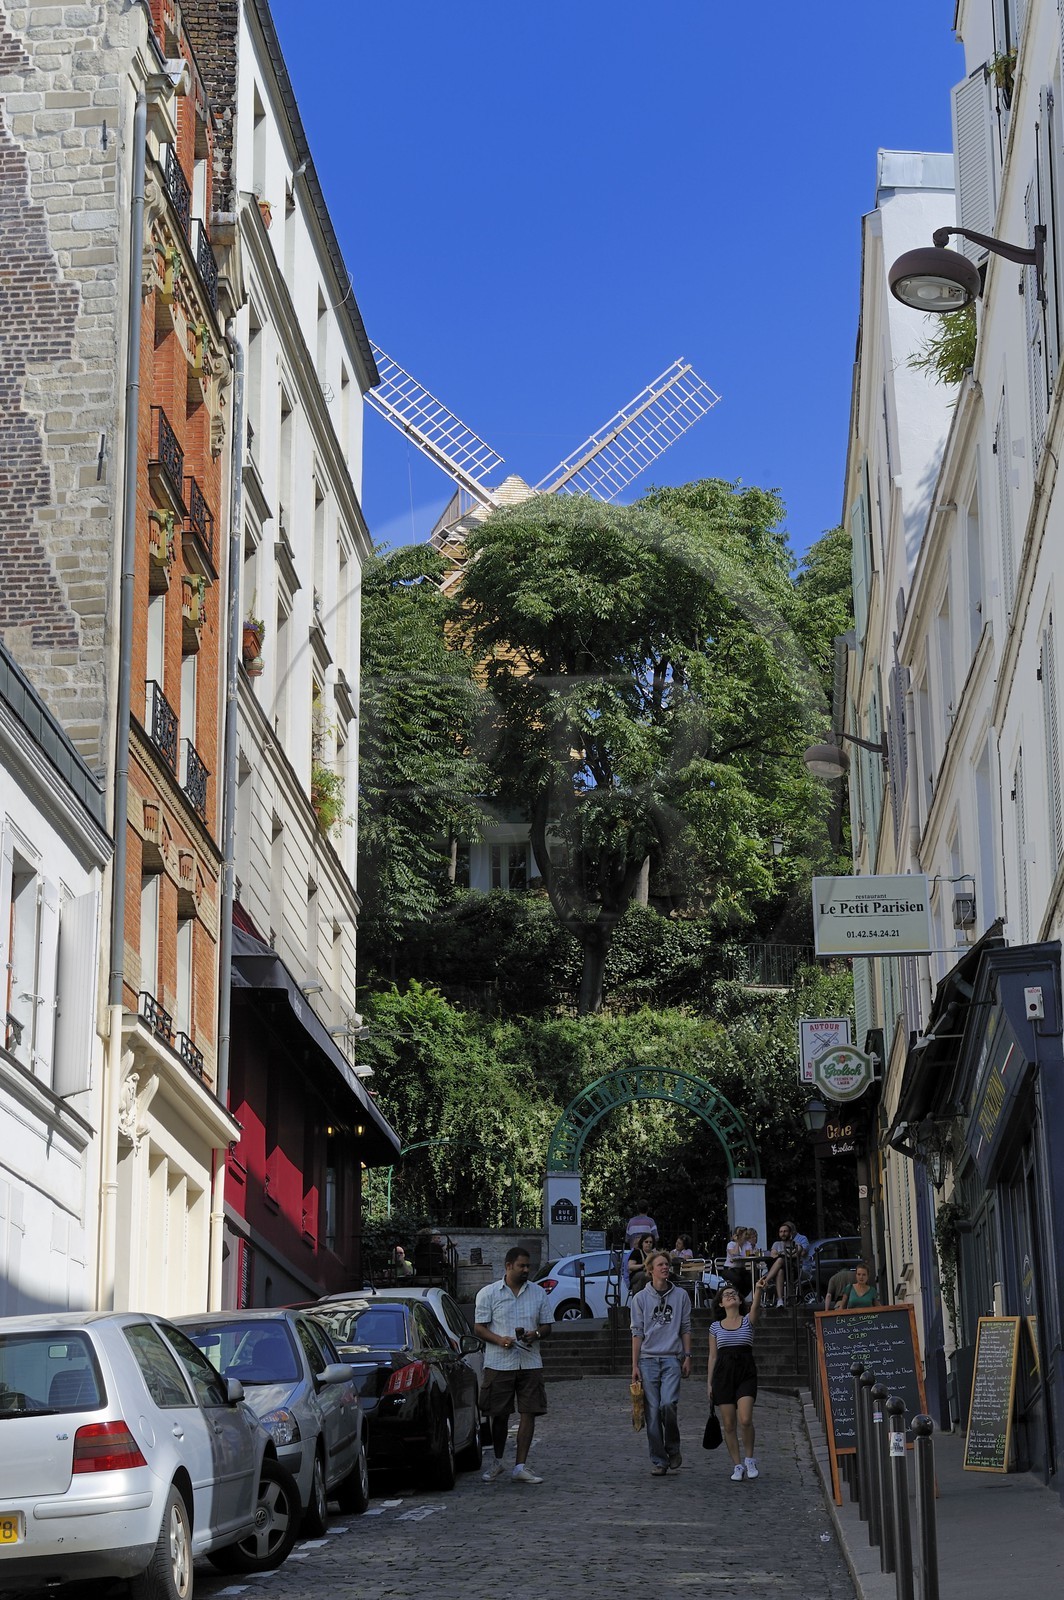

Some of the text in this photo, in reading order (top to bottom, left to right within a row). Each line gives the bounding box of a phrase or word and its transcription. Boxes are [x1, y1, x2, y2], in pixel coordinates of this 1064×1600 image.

[820, 901, 924, 915] Le Petit Parisien
[846, 930, 900, 938] 01.42.54.24.21
[809, 1023, 840, 1031] AUTOUR
[823, 1063, 862, 1079] Grolsch
[551, 1083, 614, 1171] MOULIN
[0, 1520, 13, 1539] 8
